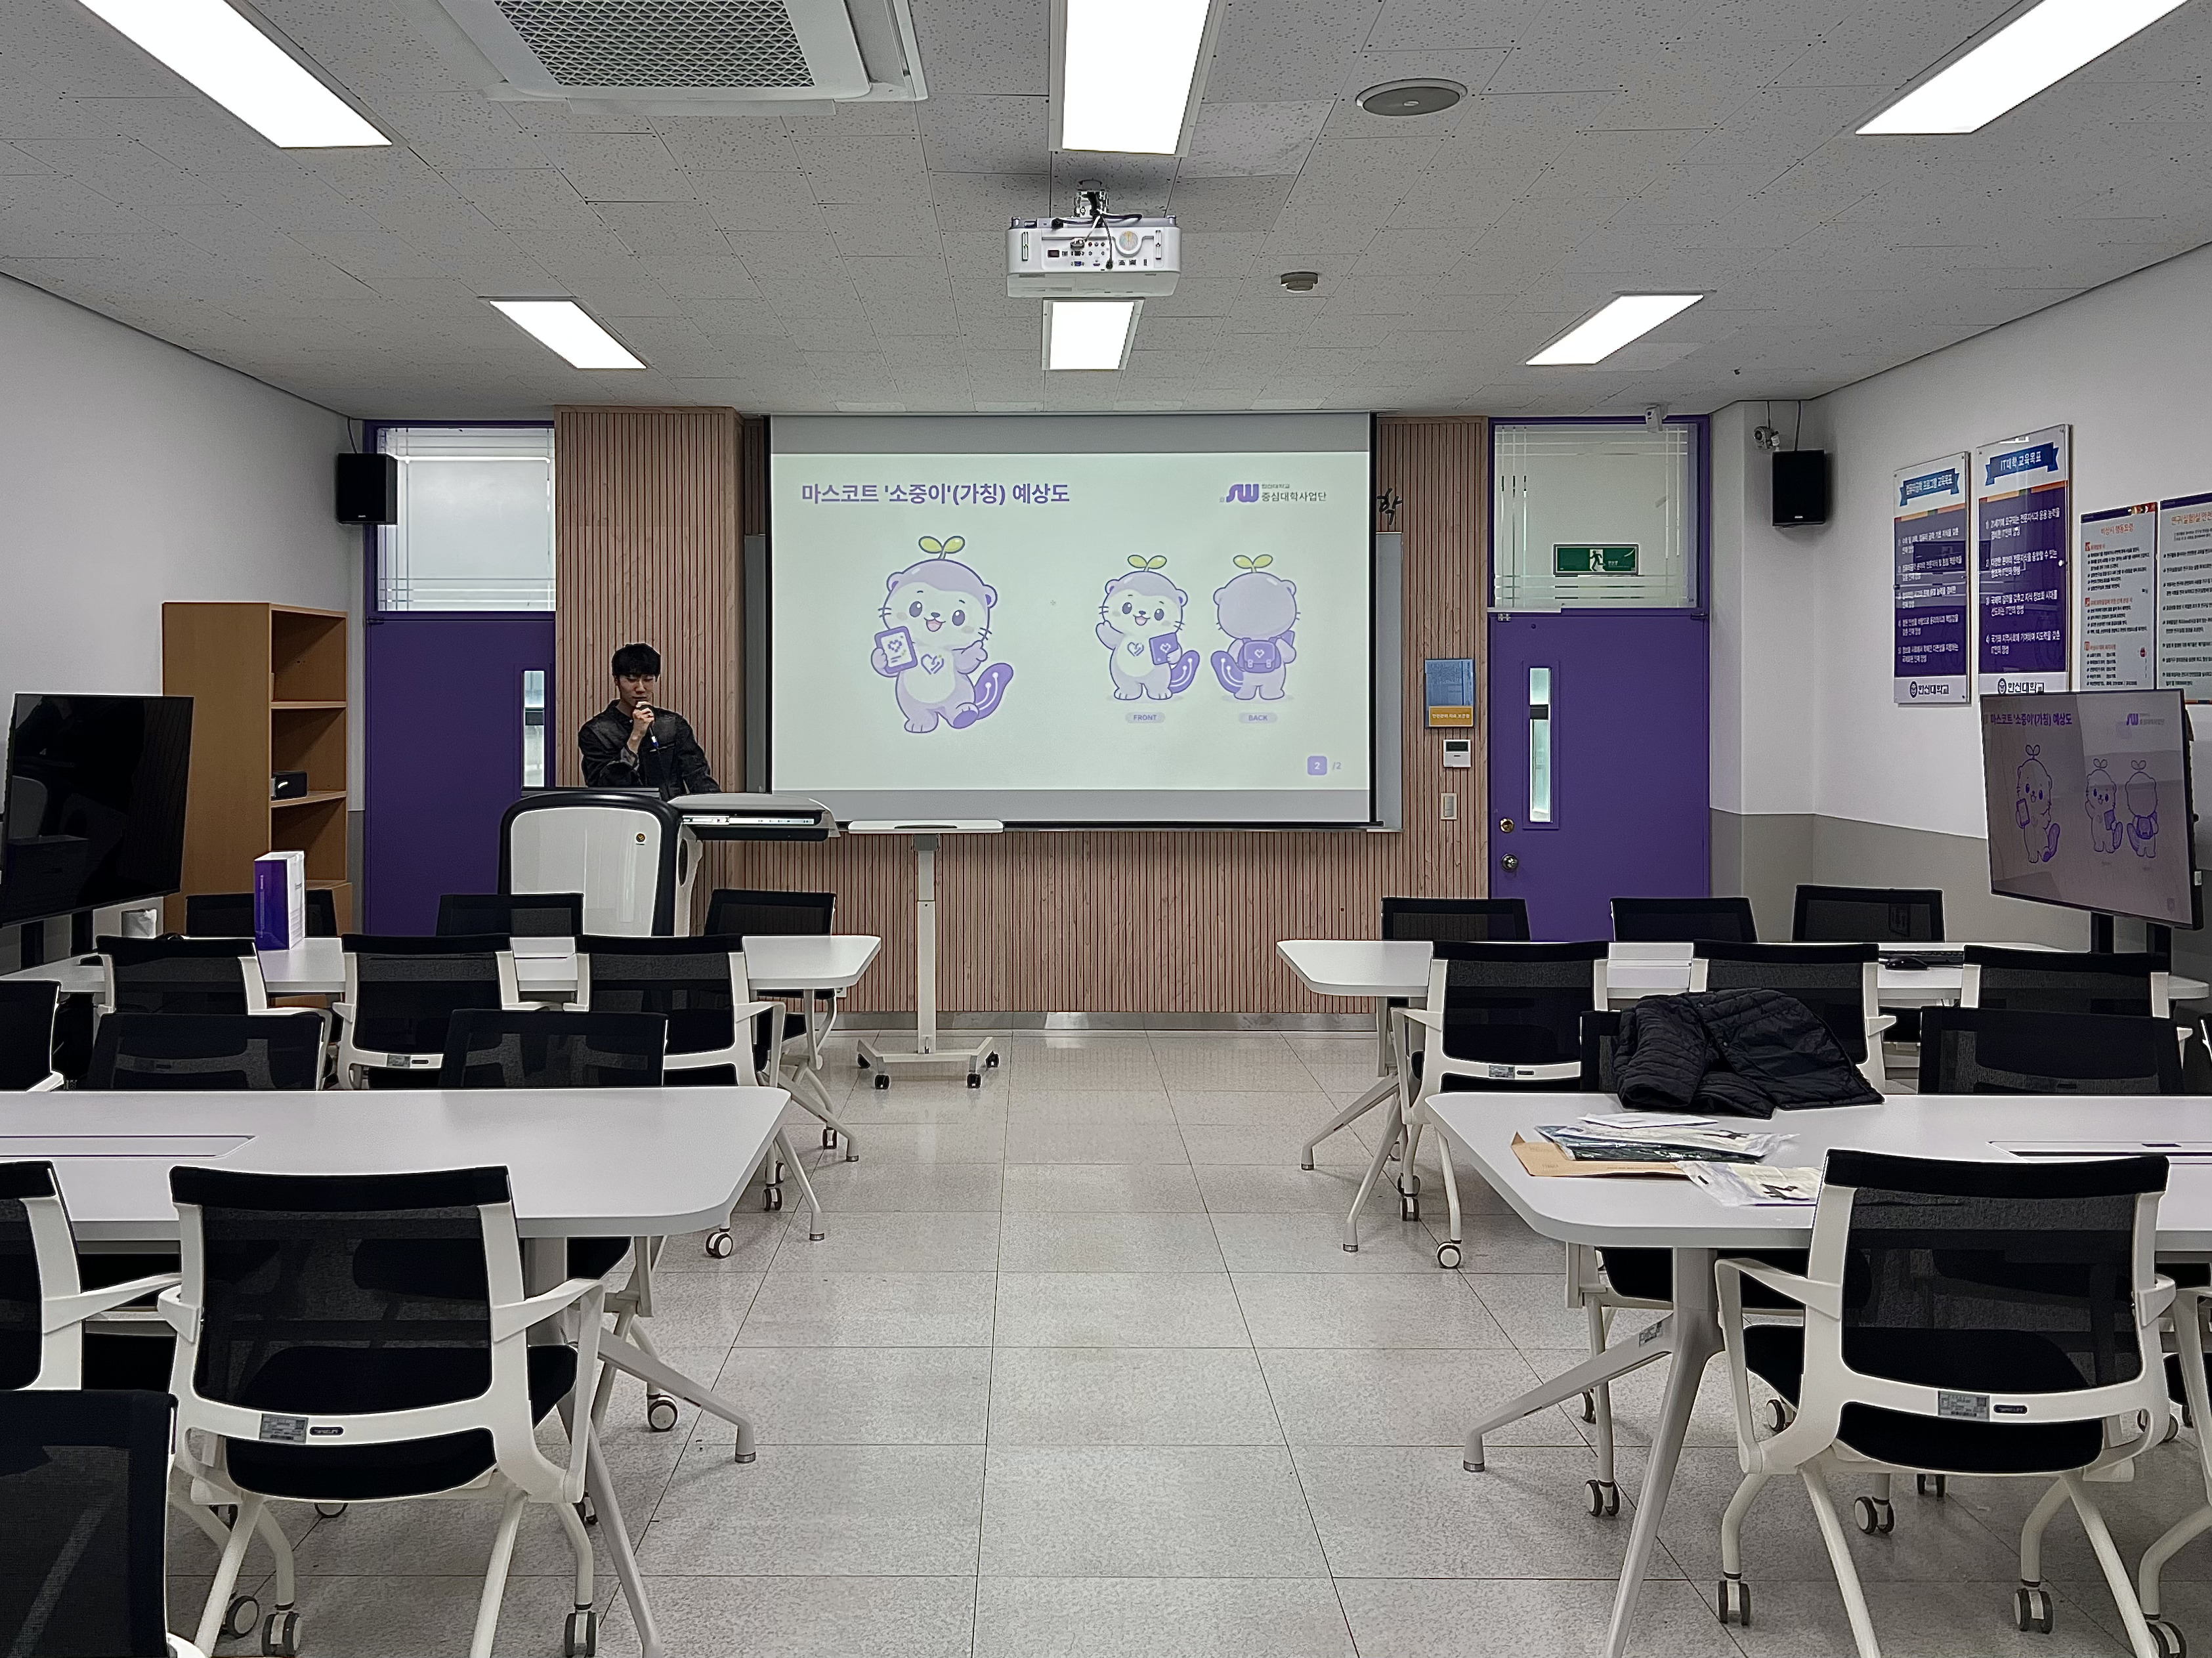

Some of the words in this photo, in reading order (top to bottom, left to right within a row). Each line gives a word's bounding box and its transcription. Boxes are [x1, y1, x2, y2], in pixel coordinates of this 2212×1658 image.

[2000, 456, 2016, 471] IT대학
[2018, 450, 2041, 467] 교육목표
[802, 484, 879, 503] 마스코트
[1012, 484, 1070, 503] 예상도
[1226, 484, 1259, 503] SW
[1262, 492, 1327, 501] 중심대학사업단
[1918, 685, 1949, 694] 한신대학교
[2007, 683, 2045, 693] 한신대학교
[1990, 714, 2012, 725] 마스코트
[2052, 713, 2072, 725] 예상도
[1332, 762, 1342, 771] /2
